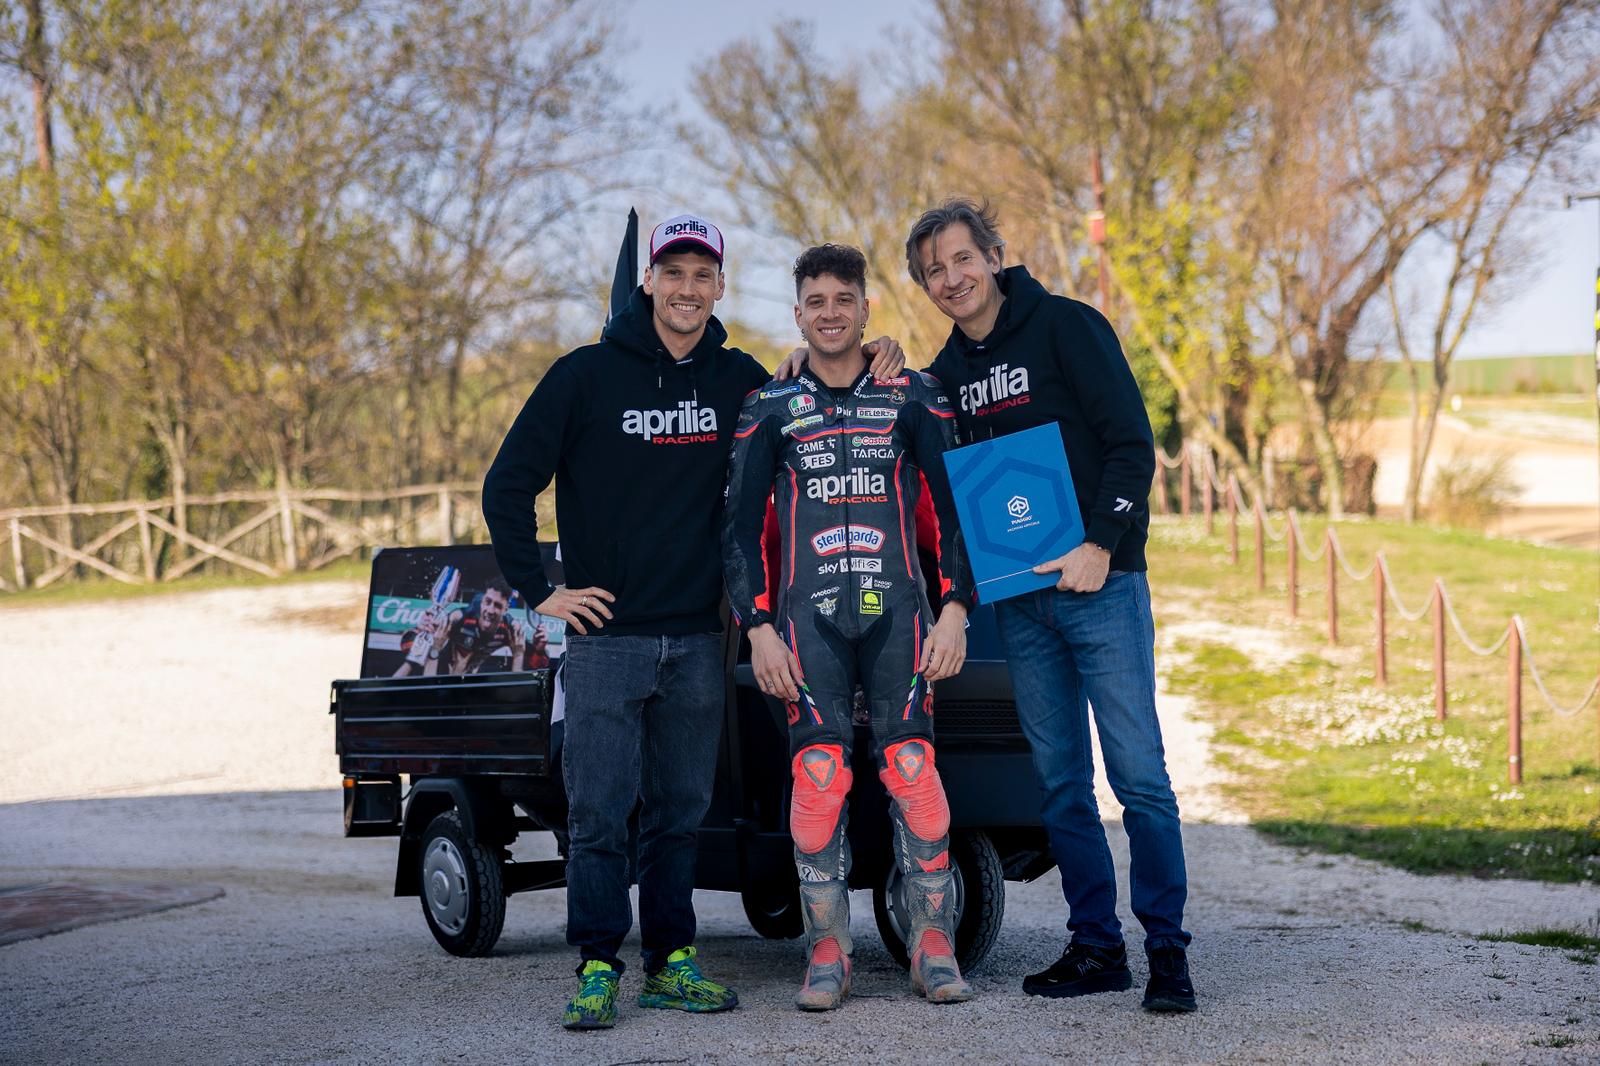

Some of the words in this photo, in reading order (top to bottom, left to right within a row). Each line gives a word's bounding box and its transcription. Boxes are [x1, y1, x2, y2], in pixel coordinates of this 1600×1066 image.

[665, 220, 708, 236] aprilia
[676, 231, 708, 239] RACING
[798, 376, 818, 393] aprilia
[959, 363, 1030, 416] aprilia
[622, 401, 718, 440] aprilia
[652, 433, 718, 445] RACING
[862, 436, 892, 445] Castrol
[797, 440, 825, 454] CAME
[851, 448, 895, 459] TARGA
[806, 467, 886, 503] aprilia
[828, 495, 888, 504] RACING
[816, 528, 879, 549] sterilgarda
[818, 562, 839, 575] sky
